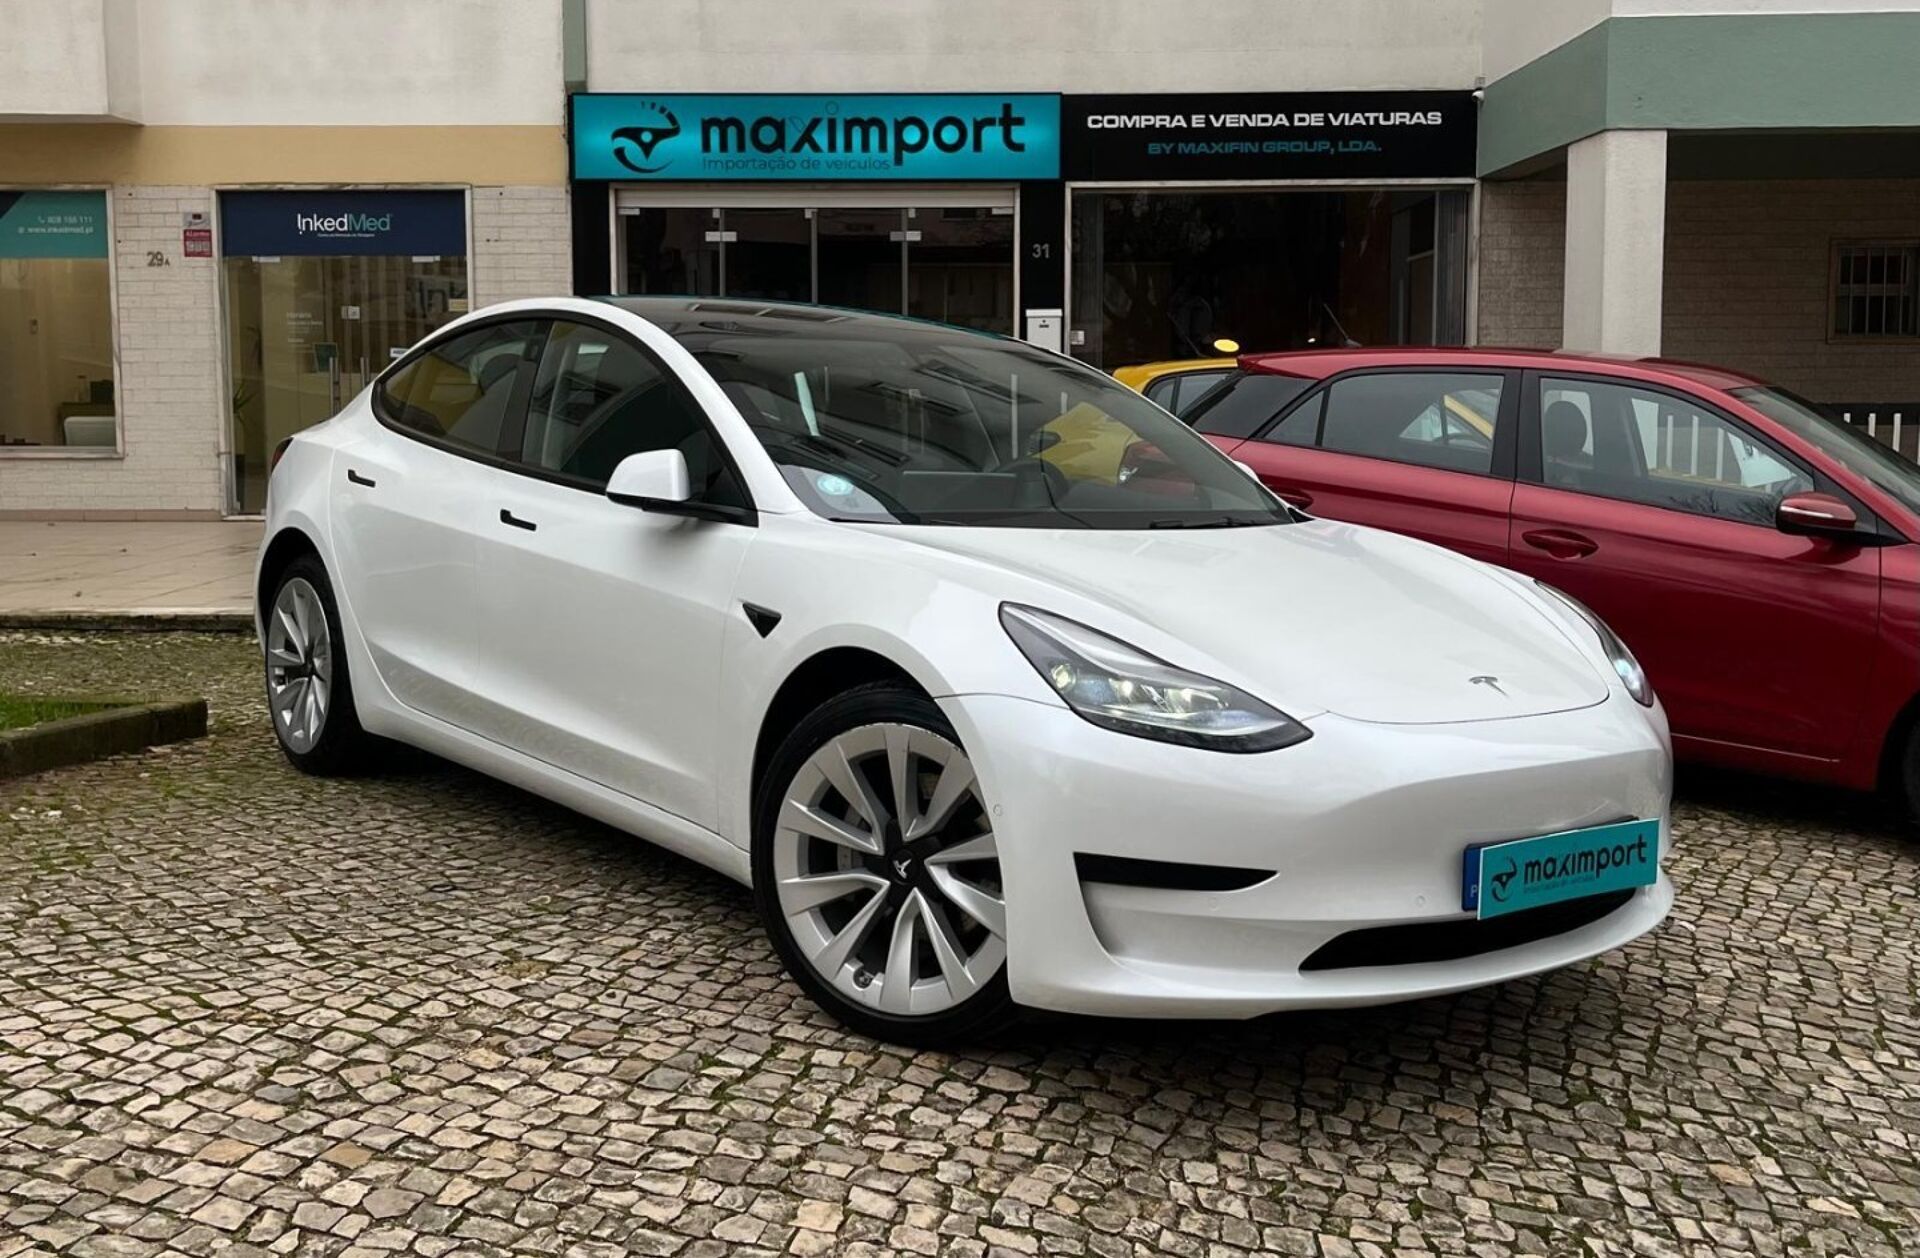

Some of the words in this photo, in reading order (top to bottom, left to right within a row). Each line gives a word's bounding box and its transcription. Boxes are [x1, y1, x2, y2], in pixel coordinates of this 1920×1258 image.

[1087, 114, 1188, 129] COMPRA
[1191, 114, 1206, 128] E
[1209, 113, 1290, 128] VENDA
[1293, 113, 1325, 127] DE
[1328, 111, 1442, 126] VIATURAS
[701, 101, 1026, 167] maximport
[1147, 143, 1176, 155] BY
[1177, 141, 1259, 154] MAXIFIN
[1262, 140, 1336, 155] GROUP,
[1337, 140, 1383, 153] LDA.
[801, 156, 821, 170] de
[297, 213, 391, 235] InkedMed
[1031, 242, 1050, 259] 31
[1523, 833, 1648, 885] maximport
